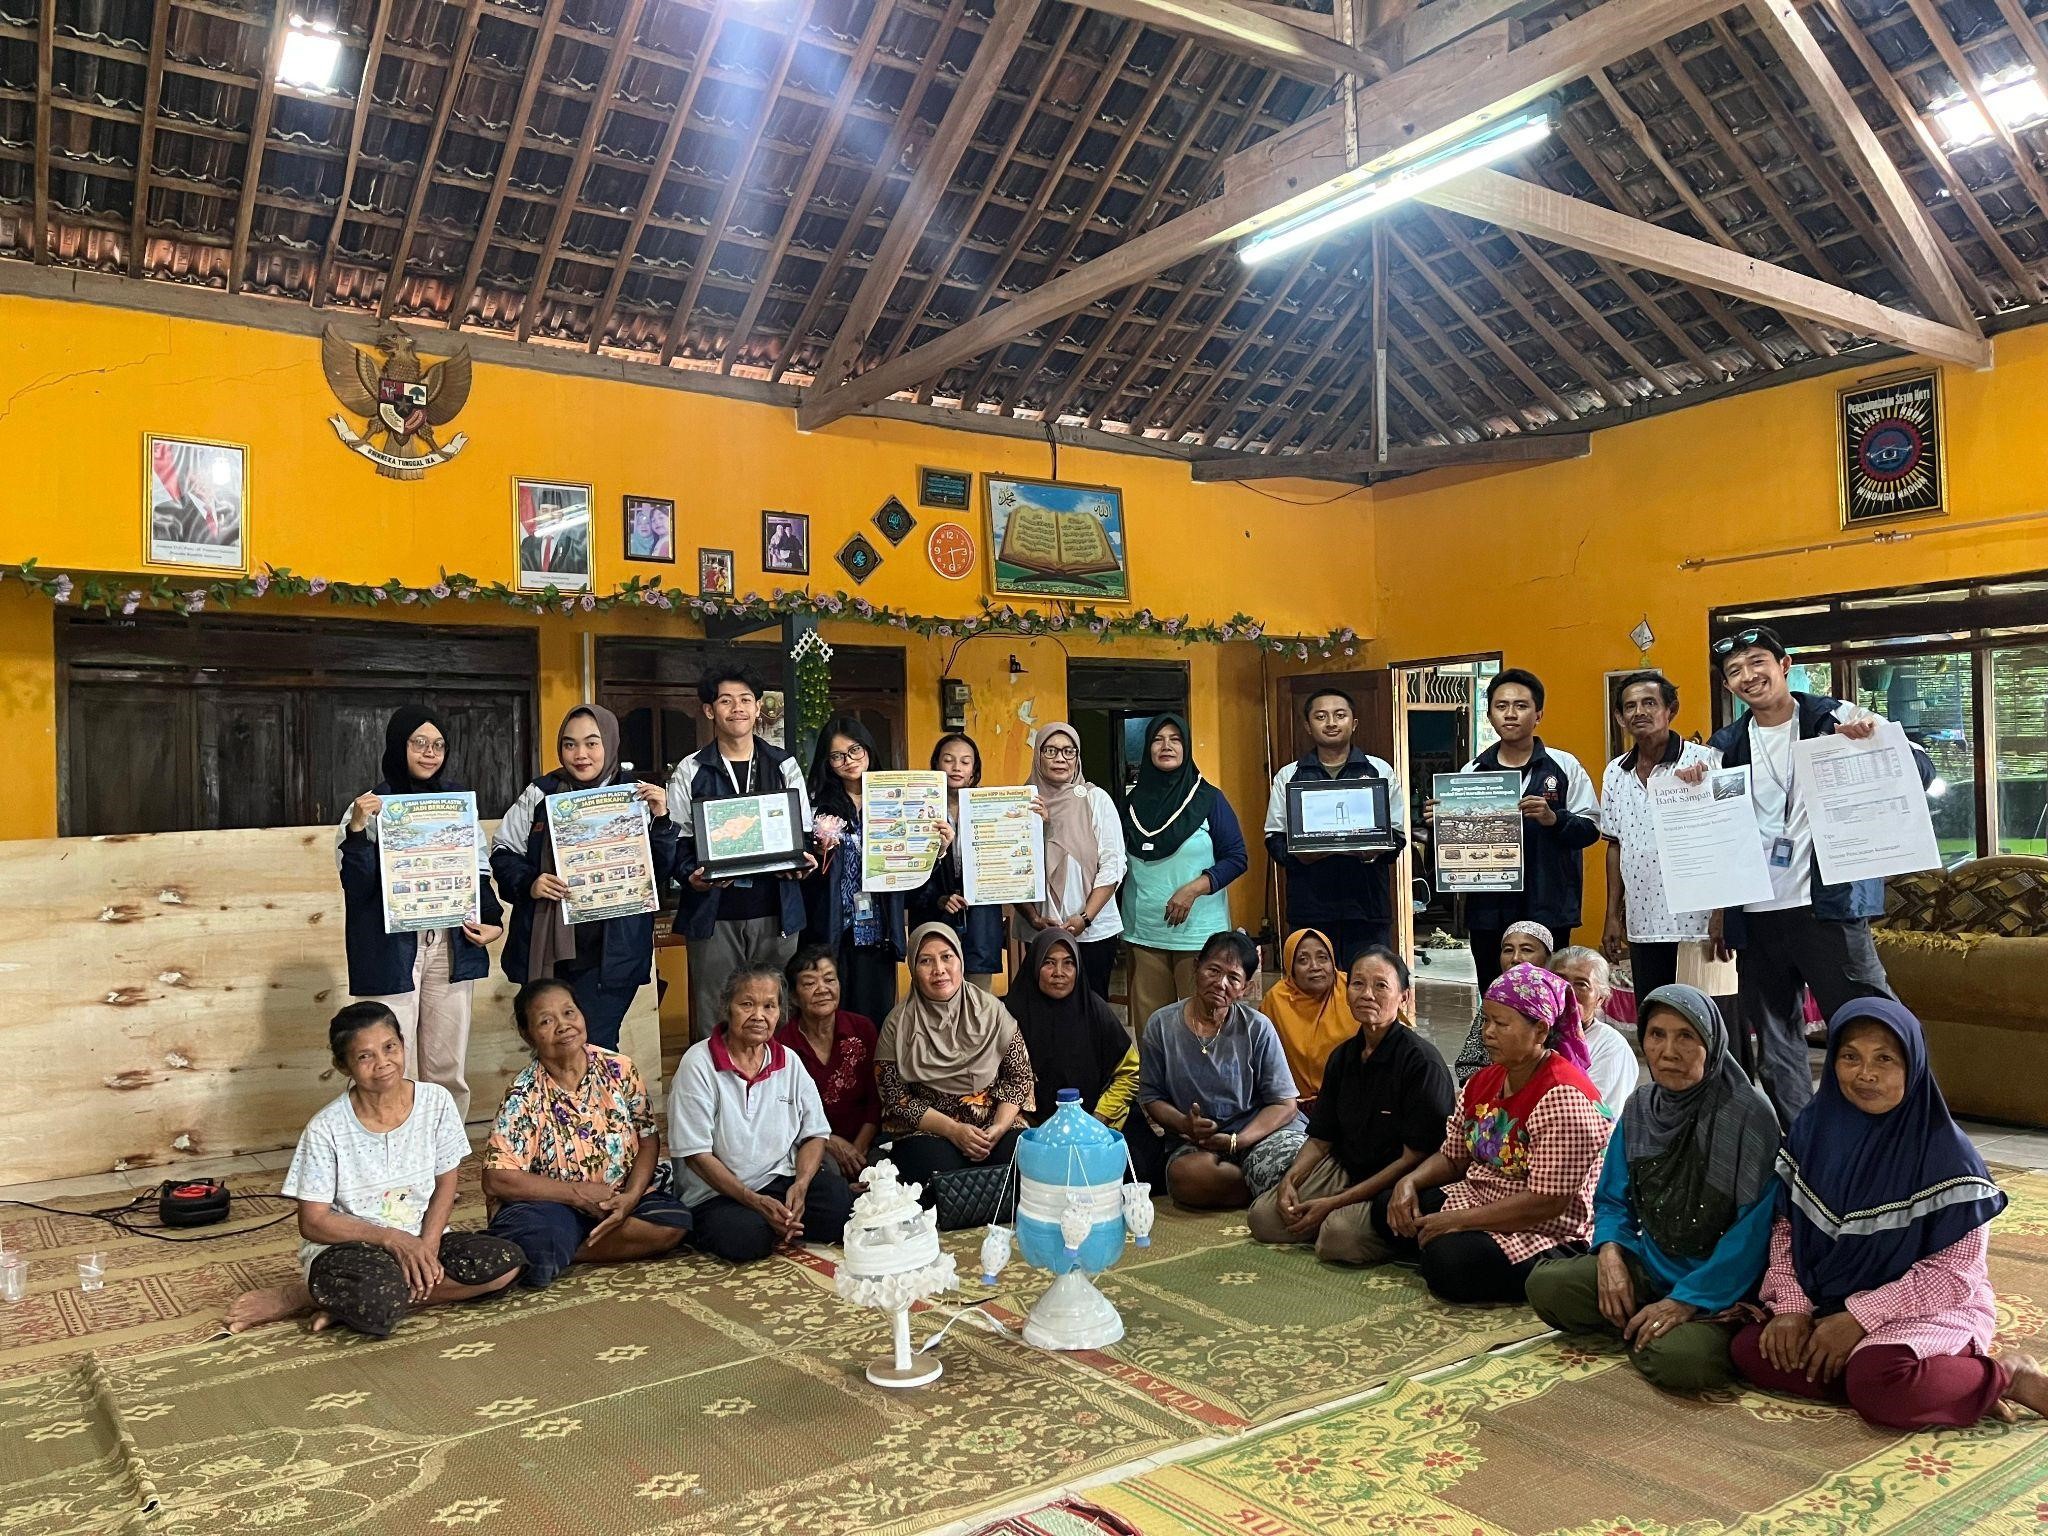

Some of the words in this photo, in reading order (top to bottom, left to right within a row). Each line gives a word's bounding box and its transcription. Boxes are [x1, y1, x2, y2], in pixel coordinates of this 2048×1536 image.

[946, 531, 954, 540] 12
[934, 546, 941, 555] 9
[961, 547, 968, 556] 3
[1654, 786, 1689, 799] Laporan
[1656, 797, 1678, 806] Bank
[1679, 790, 1712, 804] Sampah
